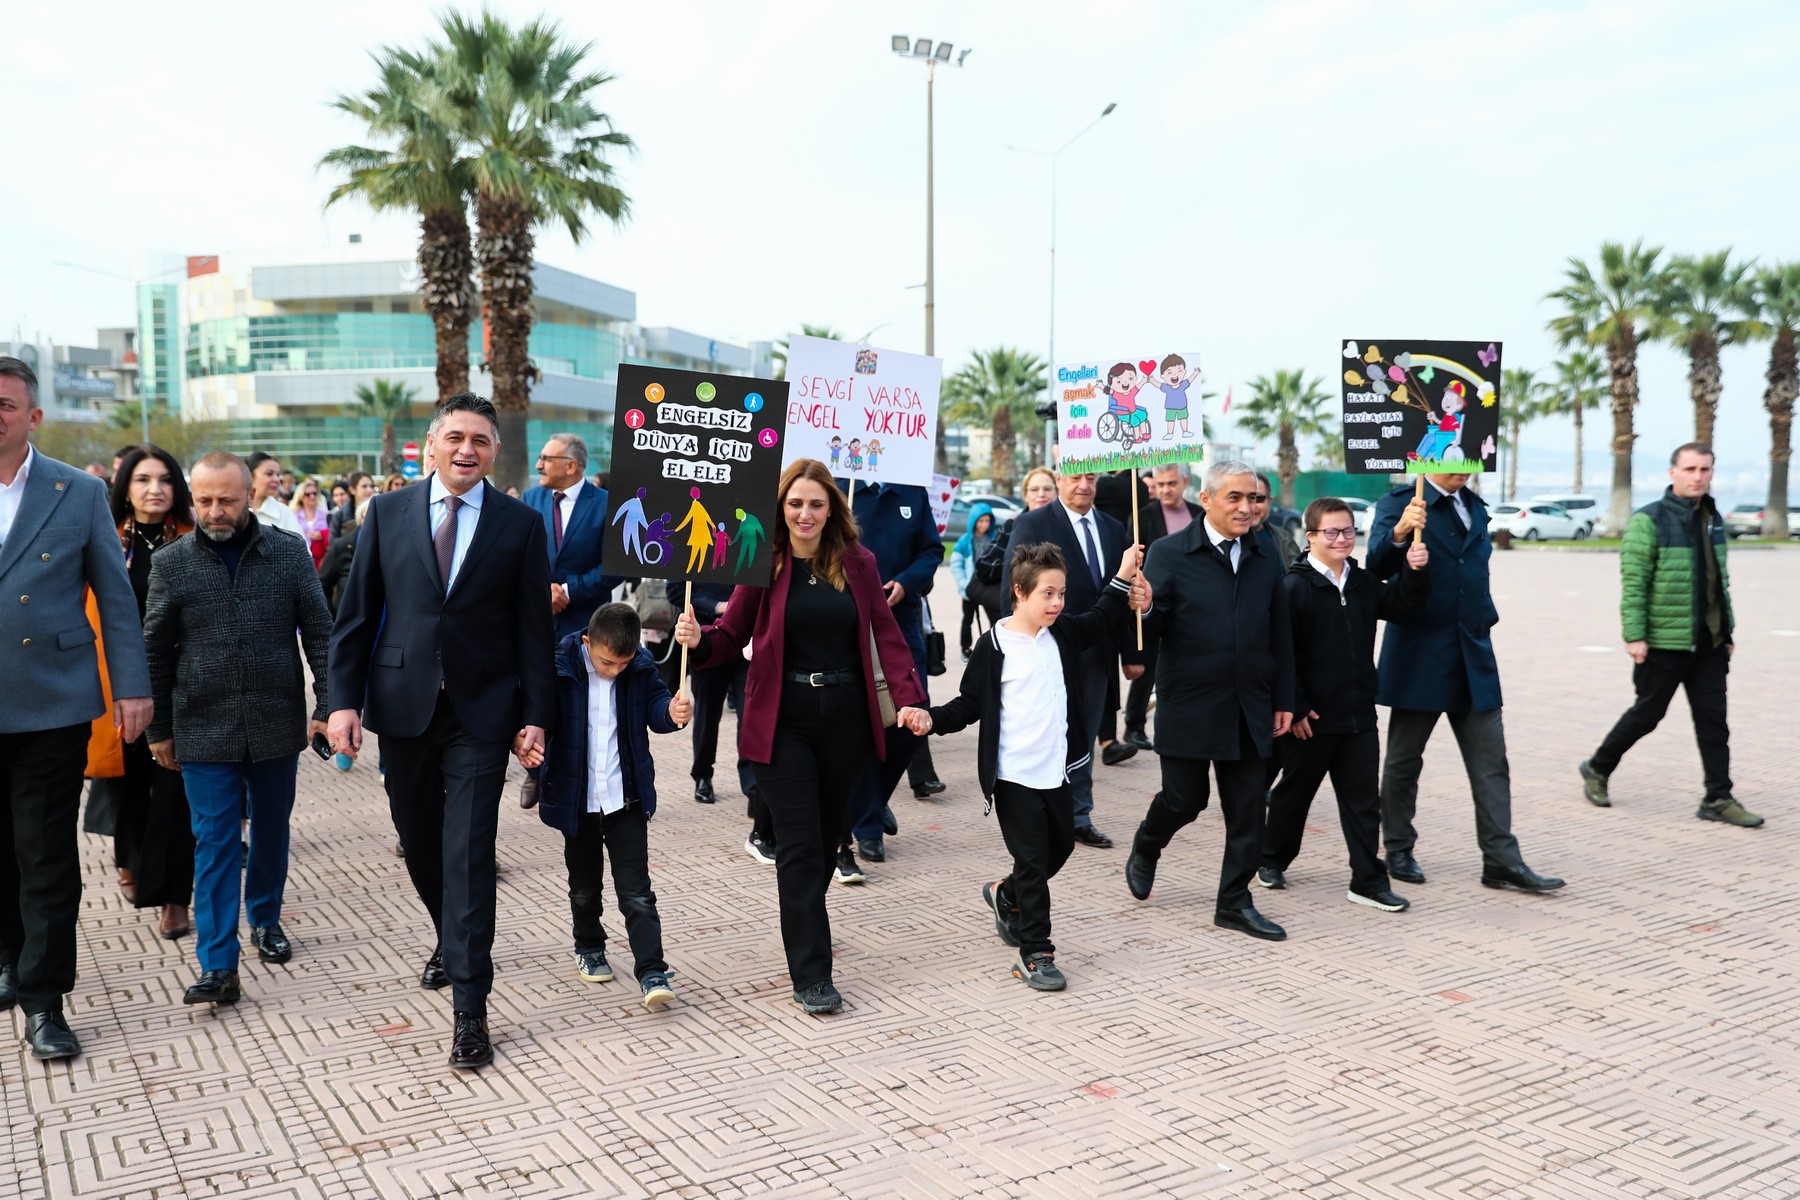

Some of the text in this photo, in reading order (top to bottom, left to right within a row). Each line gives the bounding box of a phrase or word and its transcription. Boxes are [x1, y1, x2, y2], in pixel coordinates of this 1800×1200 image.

[1058, 365, 1098, 384] Engelleri
[798, 375, 922, 410] SEVGİ VARSA
[1063, 383, 1096, 401] aşmak
[661, 407, 747, 429] ENGELSİZ
[1070, 404, 1088, 418] için
[787, 402, 928, 440] ENGEL YOKTUR
[1067, 423, 1092, 439] el ele
[637, 430, 750, 460] DÜNYA İÇİN
[1348, 439, 1380, 449] ENGEL
[667, 462, 726, 481] EL ELE
[1365, 458, 1404, 469] YOKTUR
